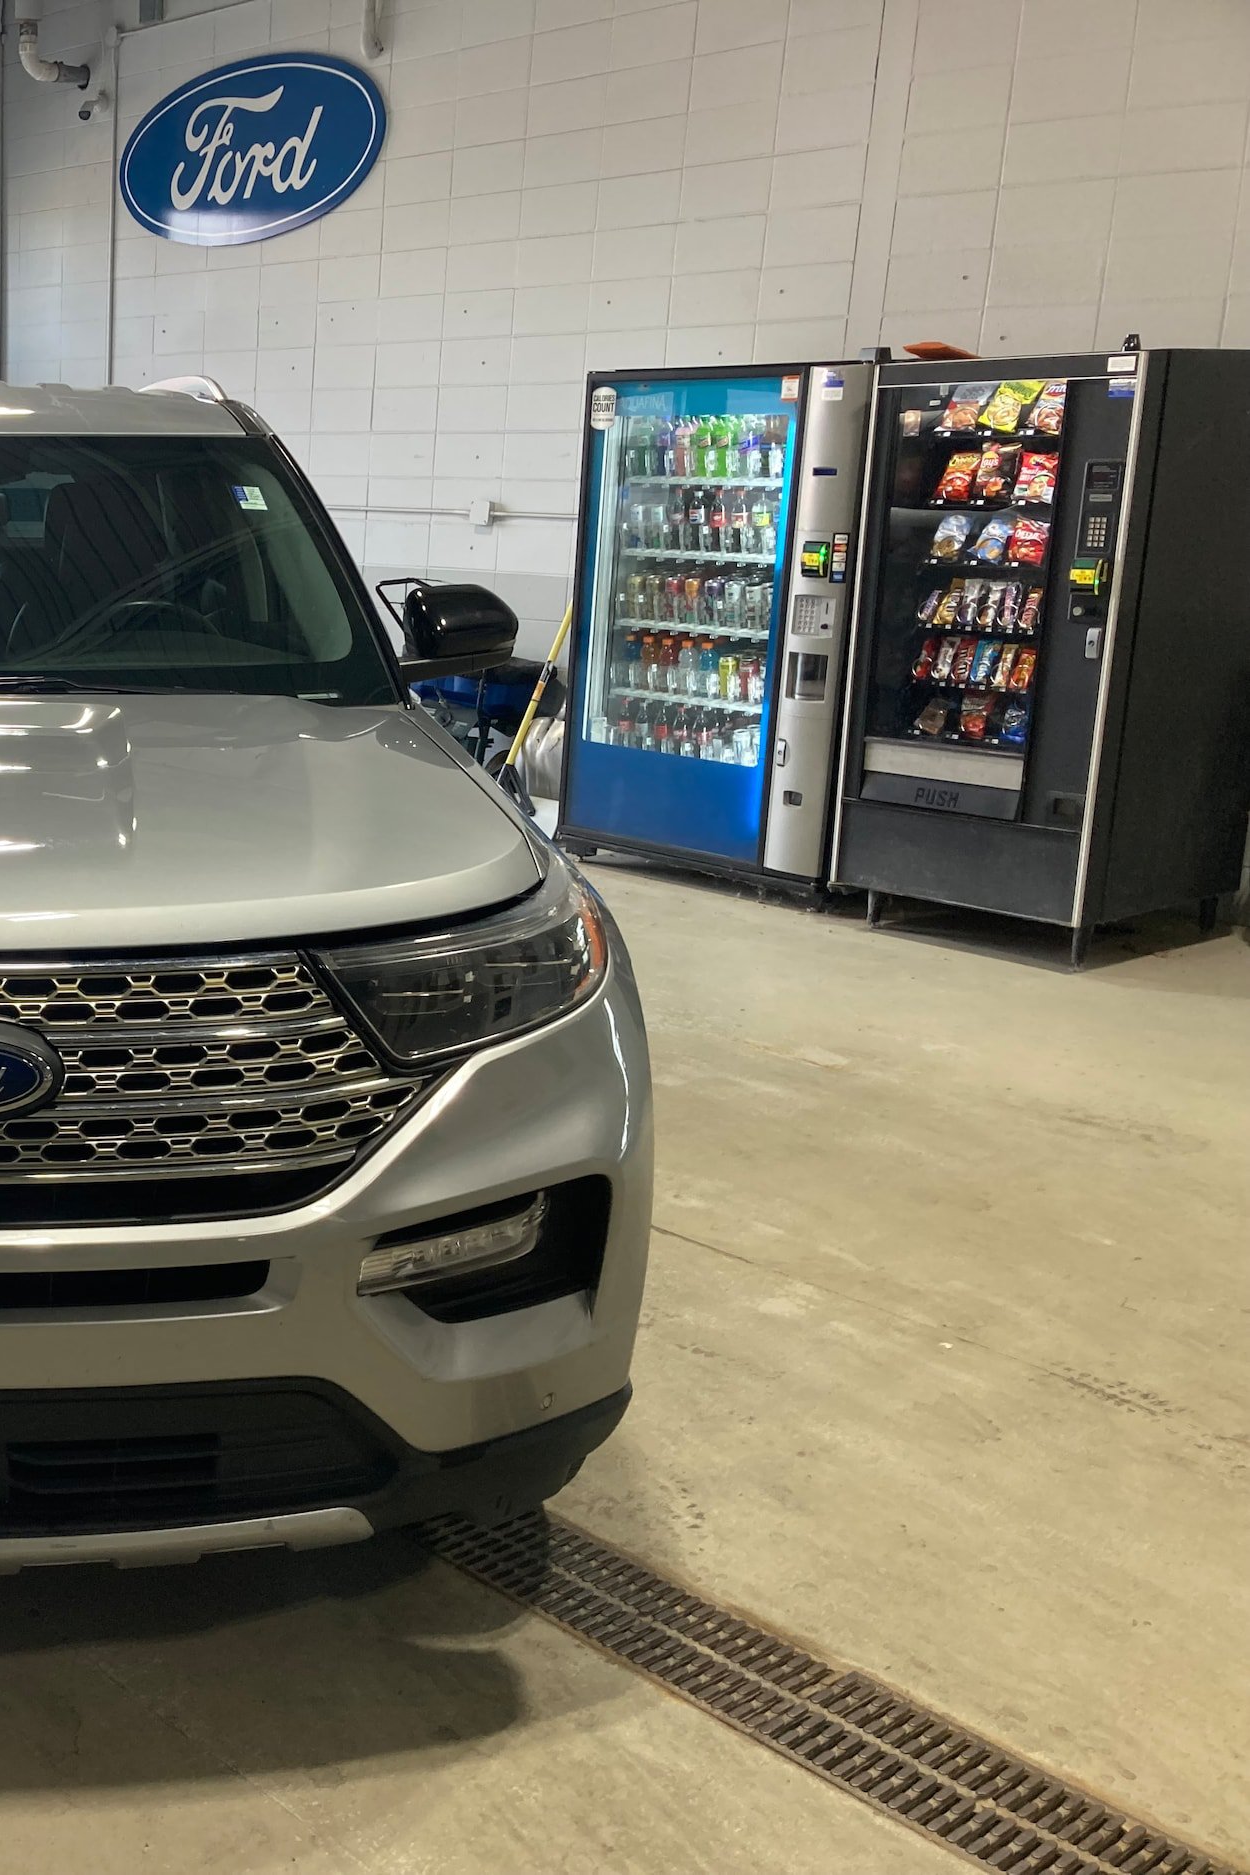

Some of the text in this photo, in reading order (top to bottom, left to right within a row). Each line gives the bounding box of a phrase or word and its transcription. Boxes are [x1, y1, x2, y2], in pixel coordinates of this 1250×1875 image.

[170, 85, 324, 211] Ford
[593, 394, 615, 402] CALORIES
[592, 402, 615, 413] COUNT
[915, 787, 960, 808] PUSH
